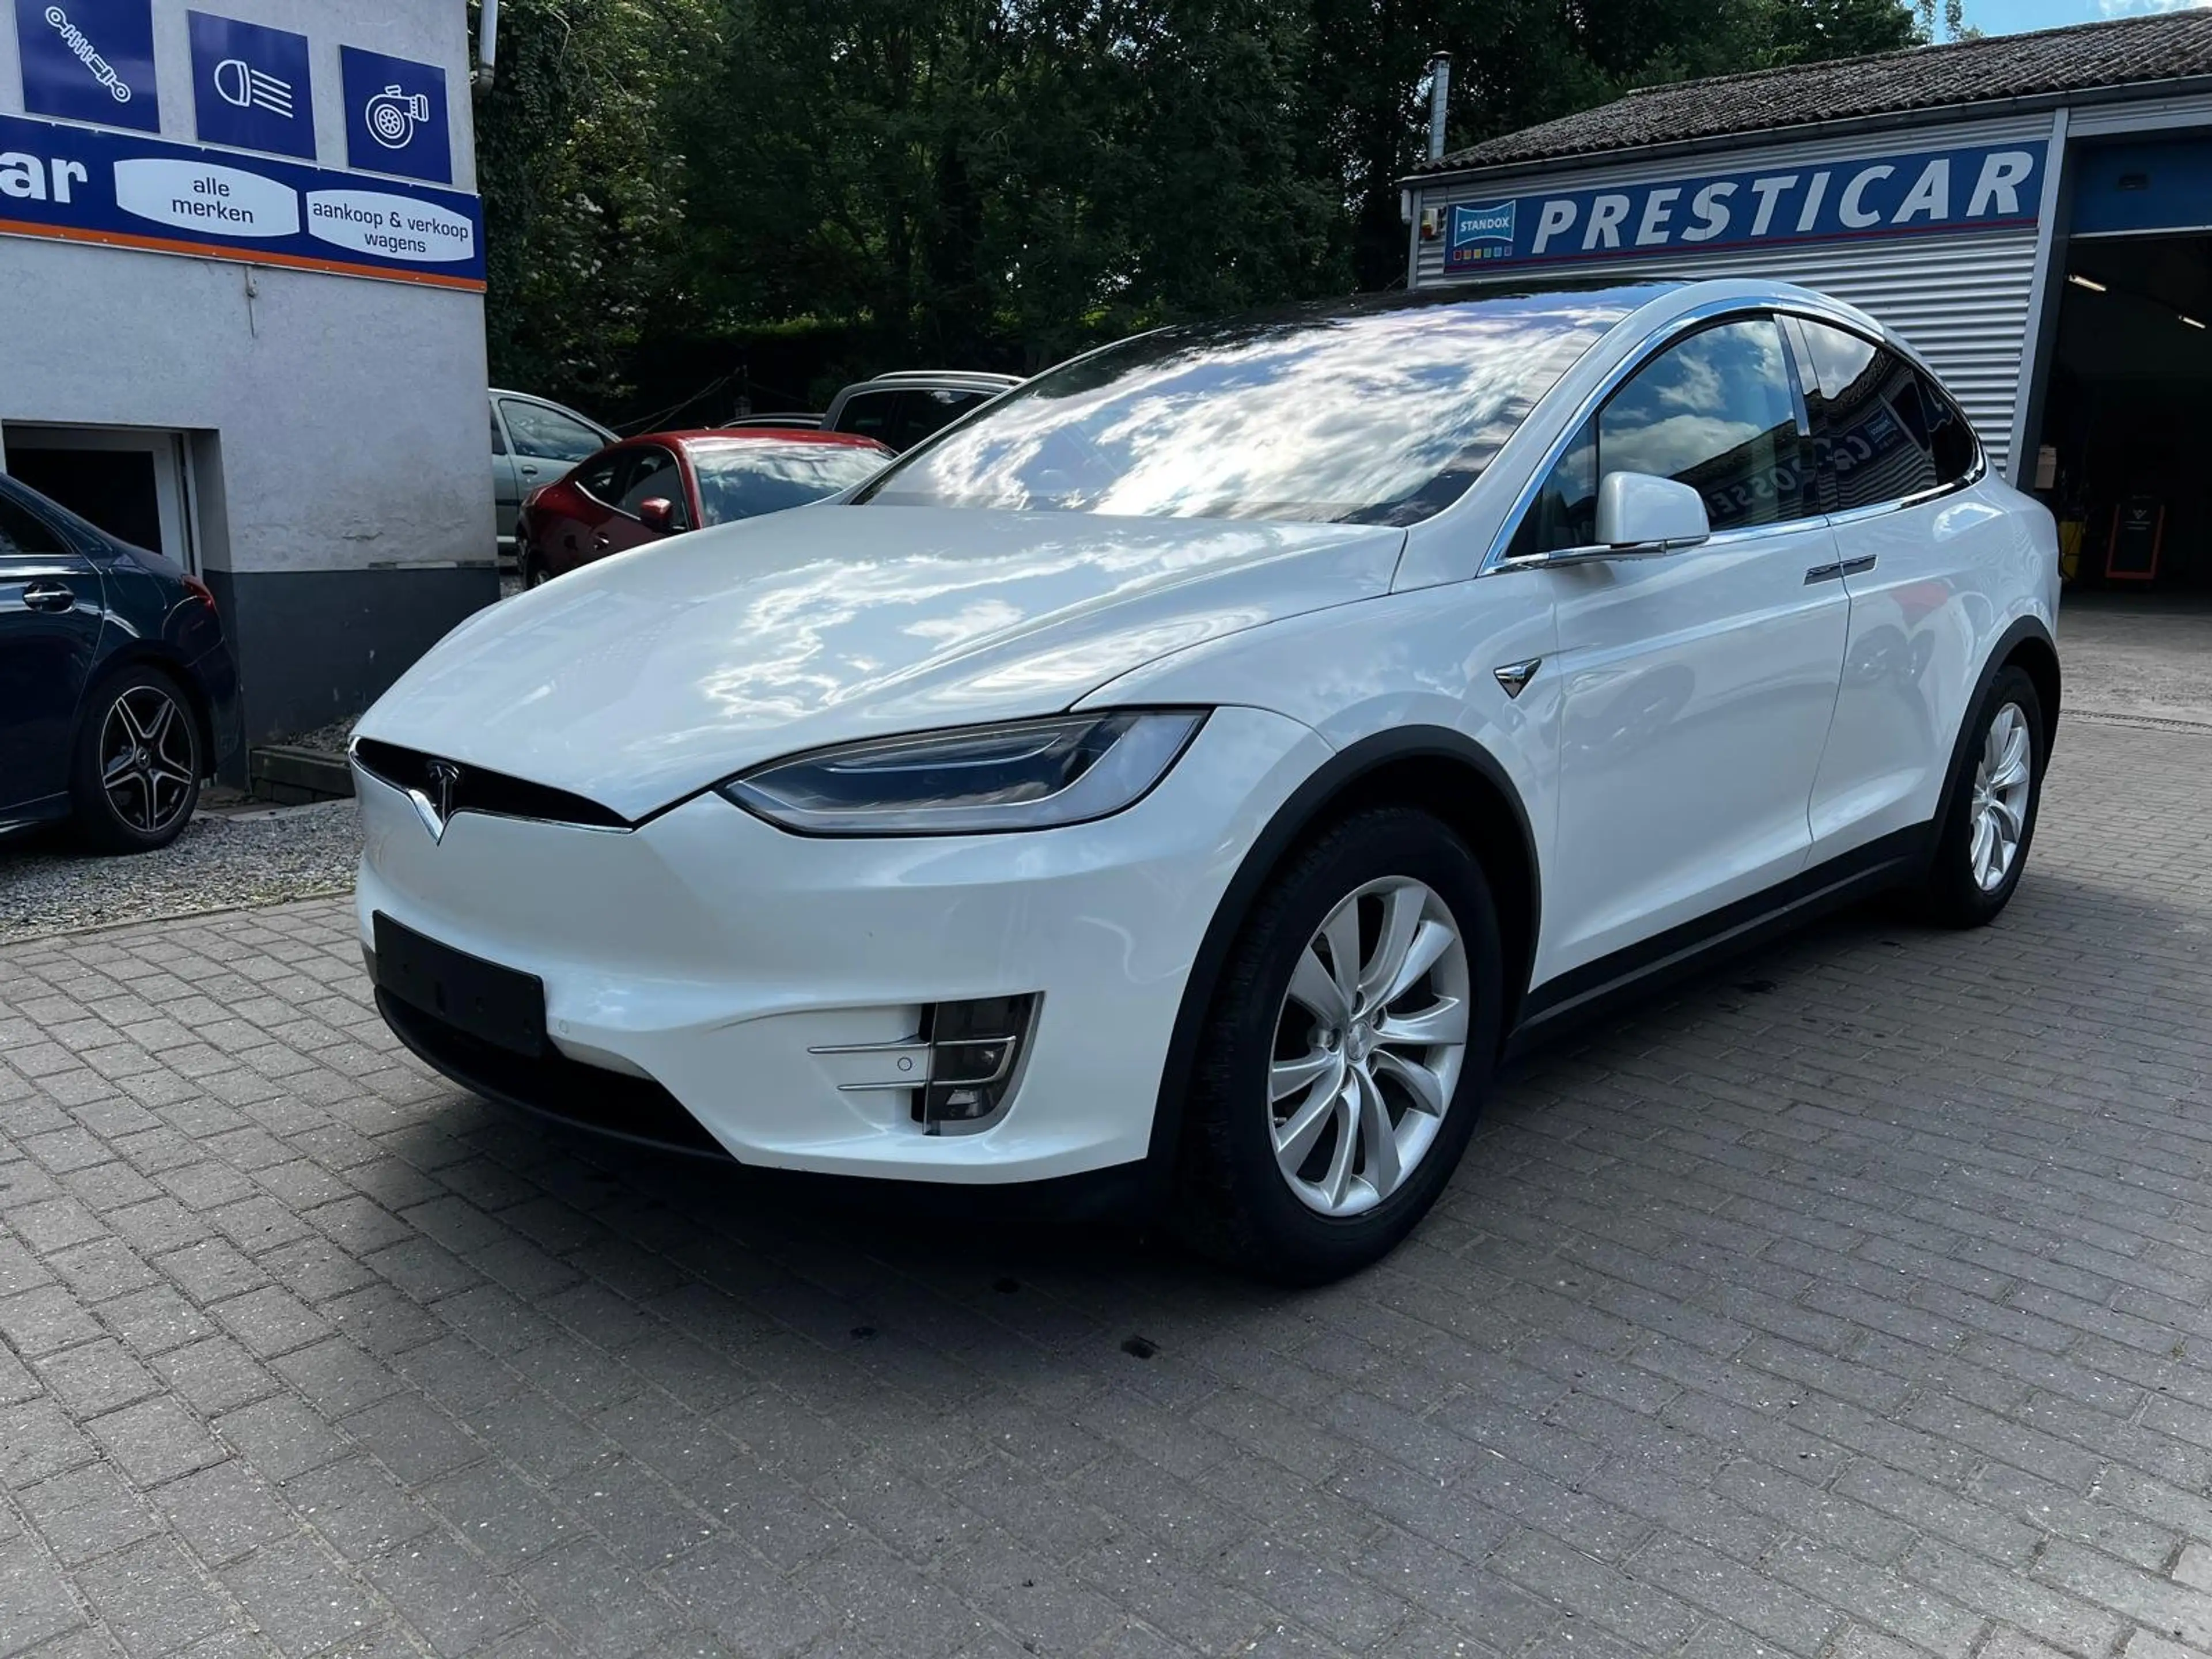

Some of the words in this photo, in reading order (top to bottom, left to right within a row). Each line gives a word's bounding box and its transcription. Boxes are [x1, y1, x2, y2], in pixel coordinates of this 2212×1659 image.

[0, 152, 88, 203] ar
[193, 177, 230, 197] alle
[172, 199, 253, 224] merken
[1532, 150, 2033, 254] PRESTICAR
[313, 203, 383, 229] aankoop
[389, 211, 402, 228] &
[407, 218, 468, 242] verkoop
[1460, 216, 1510, 232] STANDOX
[364, 233, 426, 253] wagens
